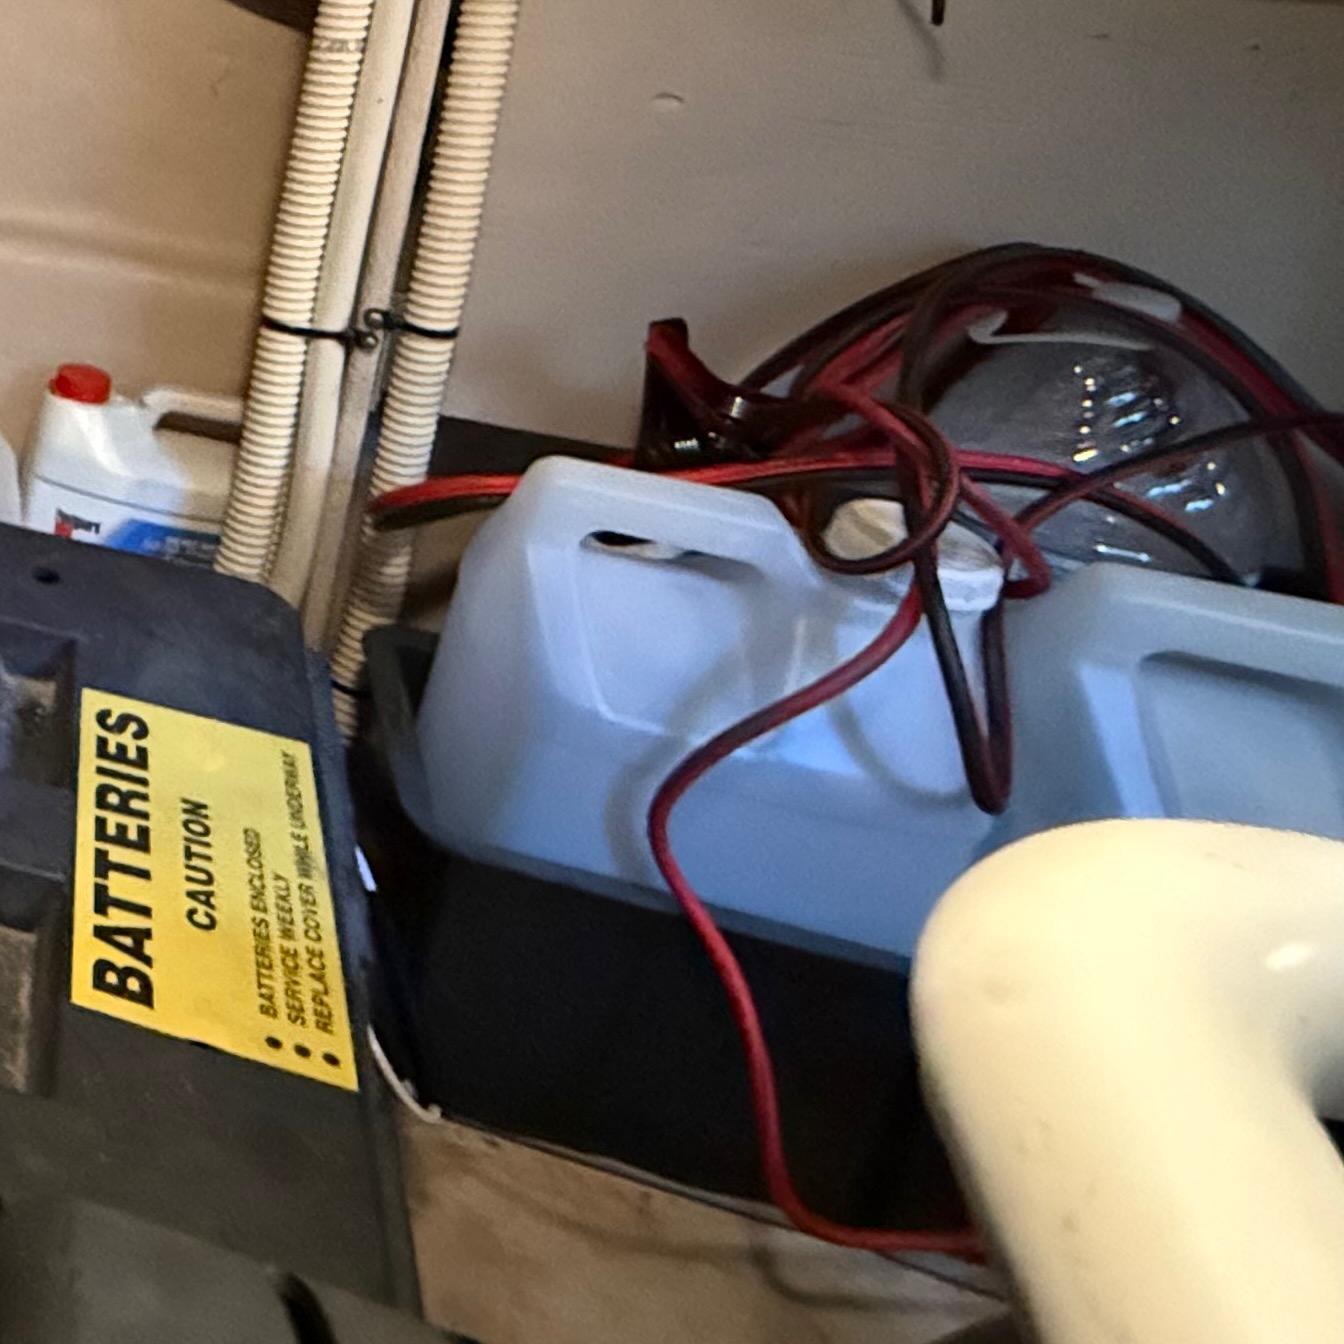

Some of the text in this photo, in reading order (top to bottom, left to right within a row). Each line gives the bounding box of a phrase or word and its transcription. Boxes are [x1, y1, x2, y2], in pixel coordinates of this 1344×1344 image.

[91, 708, 154, 1010] BATTERIES
[179, 797, 217, 932] CAUTION
[242, 827, 279, 1019] BATTERIES ENCLOSED
[298, 882, 323, 942] COVER
[273, 871, 307, 1028] SERVICE WEEKLY
[305, 945, 335, 1036] REPLACE
